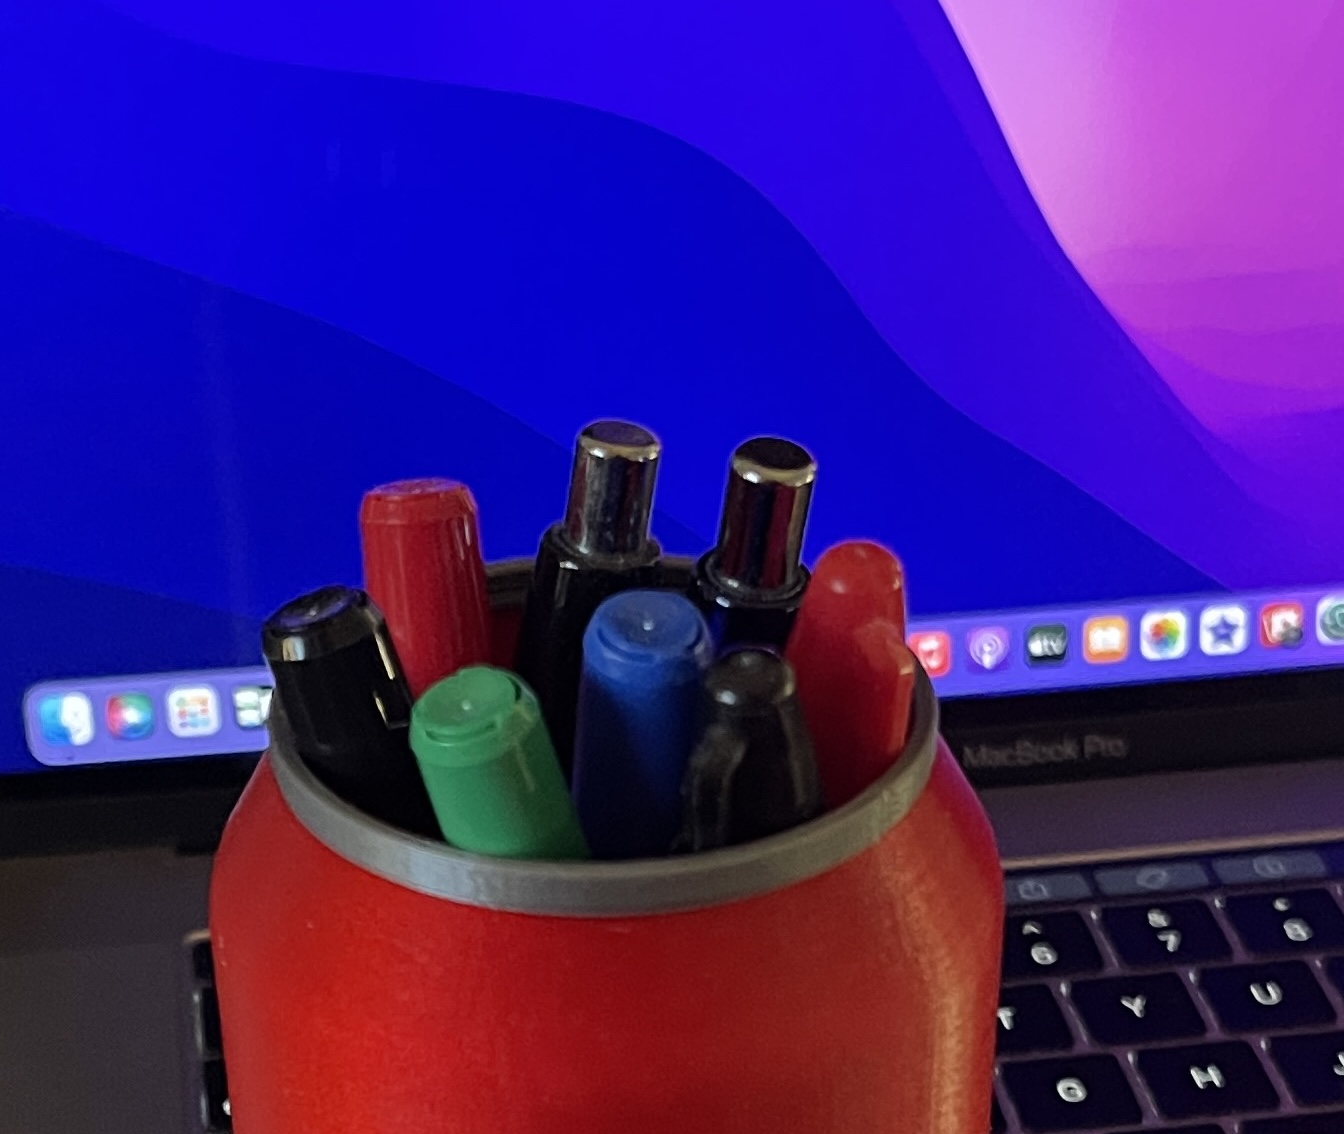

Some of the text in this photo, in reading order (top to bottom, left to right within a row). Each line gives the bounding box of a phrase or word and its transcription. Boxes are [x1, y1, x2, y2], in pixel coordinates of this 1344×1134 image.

[962, 734, 1128, 768] MacBook Pro
[1157, 930, 1180, 953] 7
[1249, 982, 1282, 1006] U
[997, 1006, 1016, 1031] T
[1120, 996, 1146, 1018] Y
[1189, 1065, 1223, 1090] H
